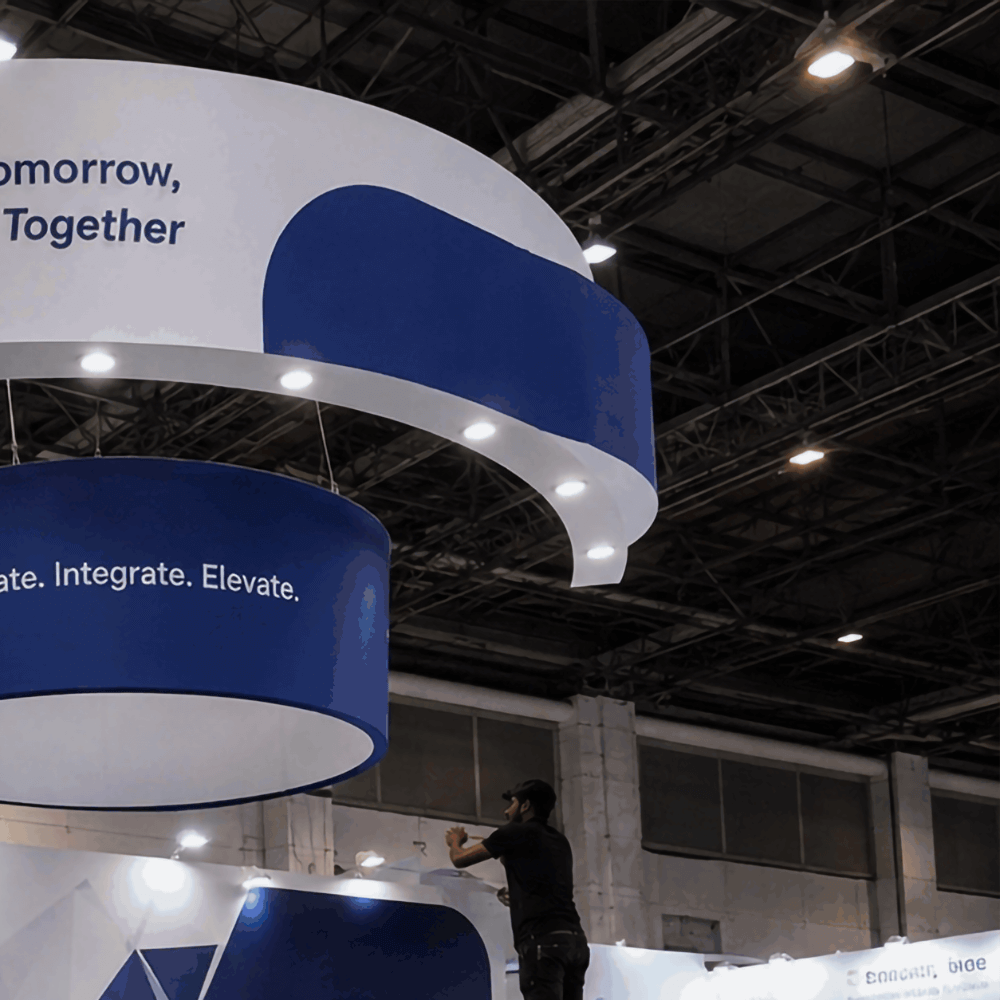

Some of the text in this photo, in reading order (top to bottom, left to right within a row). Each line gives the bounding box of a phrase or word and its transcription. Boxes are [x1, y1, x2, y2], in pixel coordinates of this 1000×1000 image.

[2, 207, 186, 250] Together
[55, 561, 193, 591] Integrate.
[202, 563, 299, 602] Elevate.
